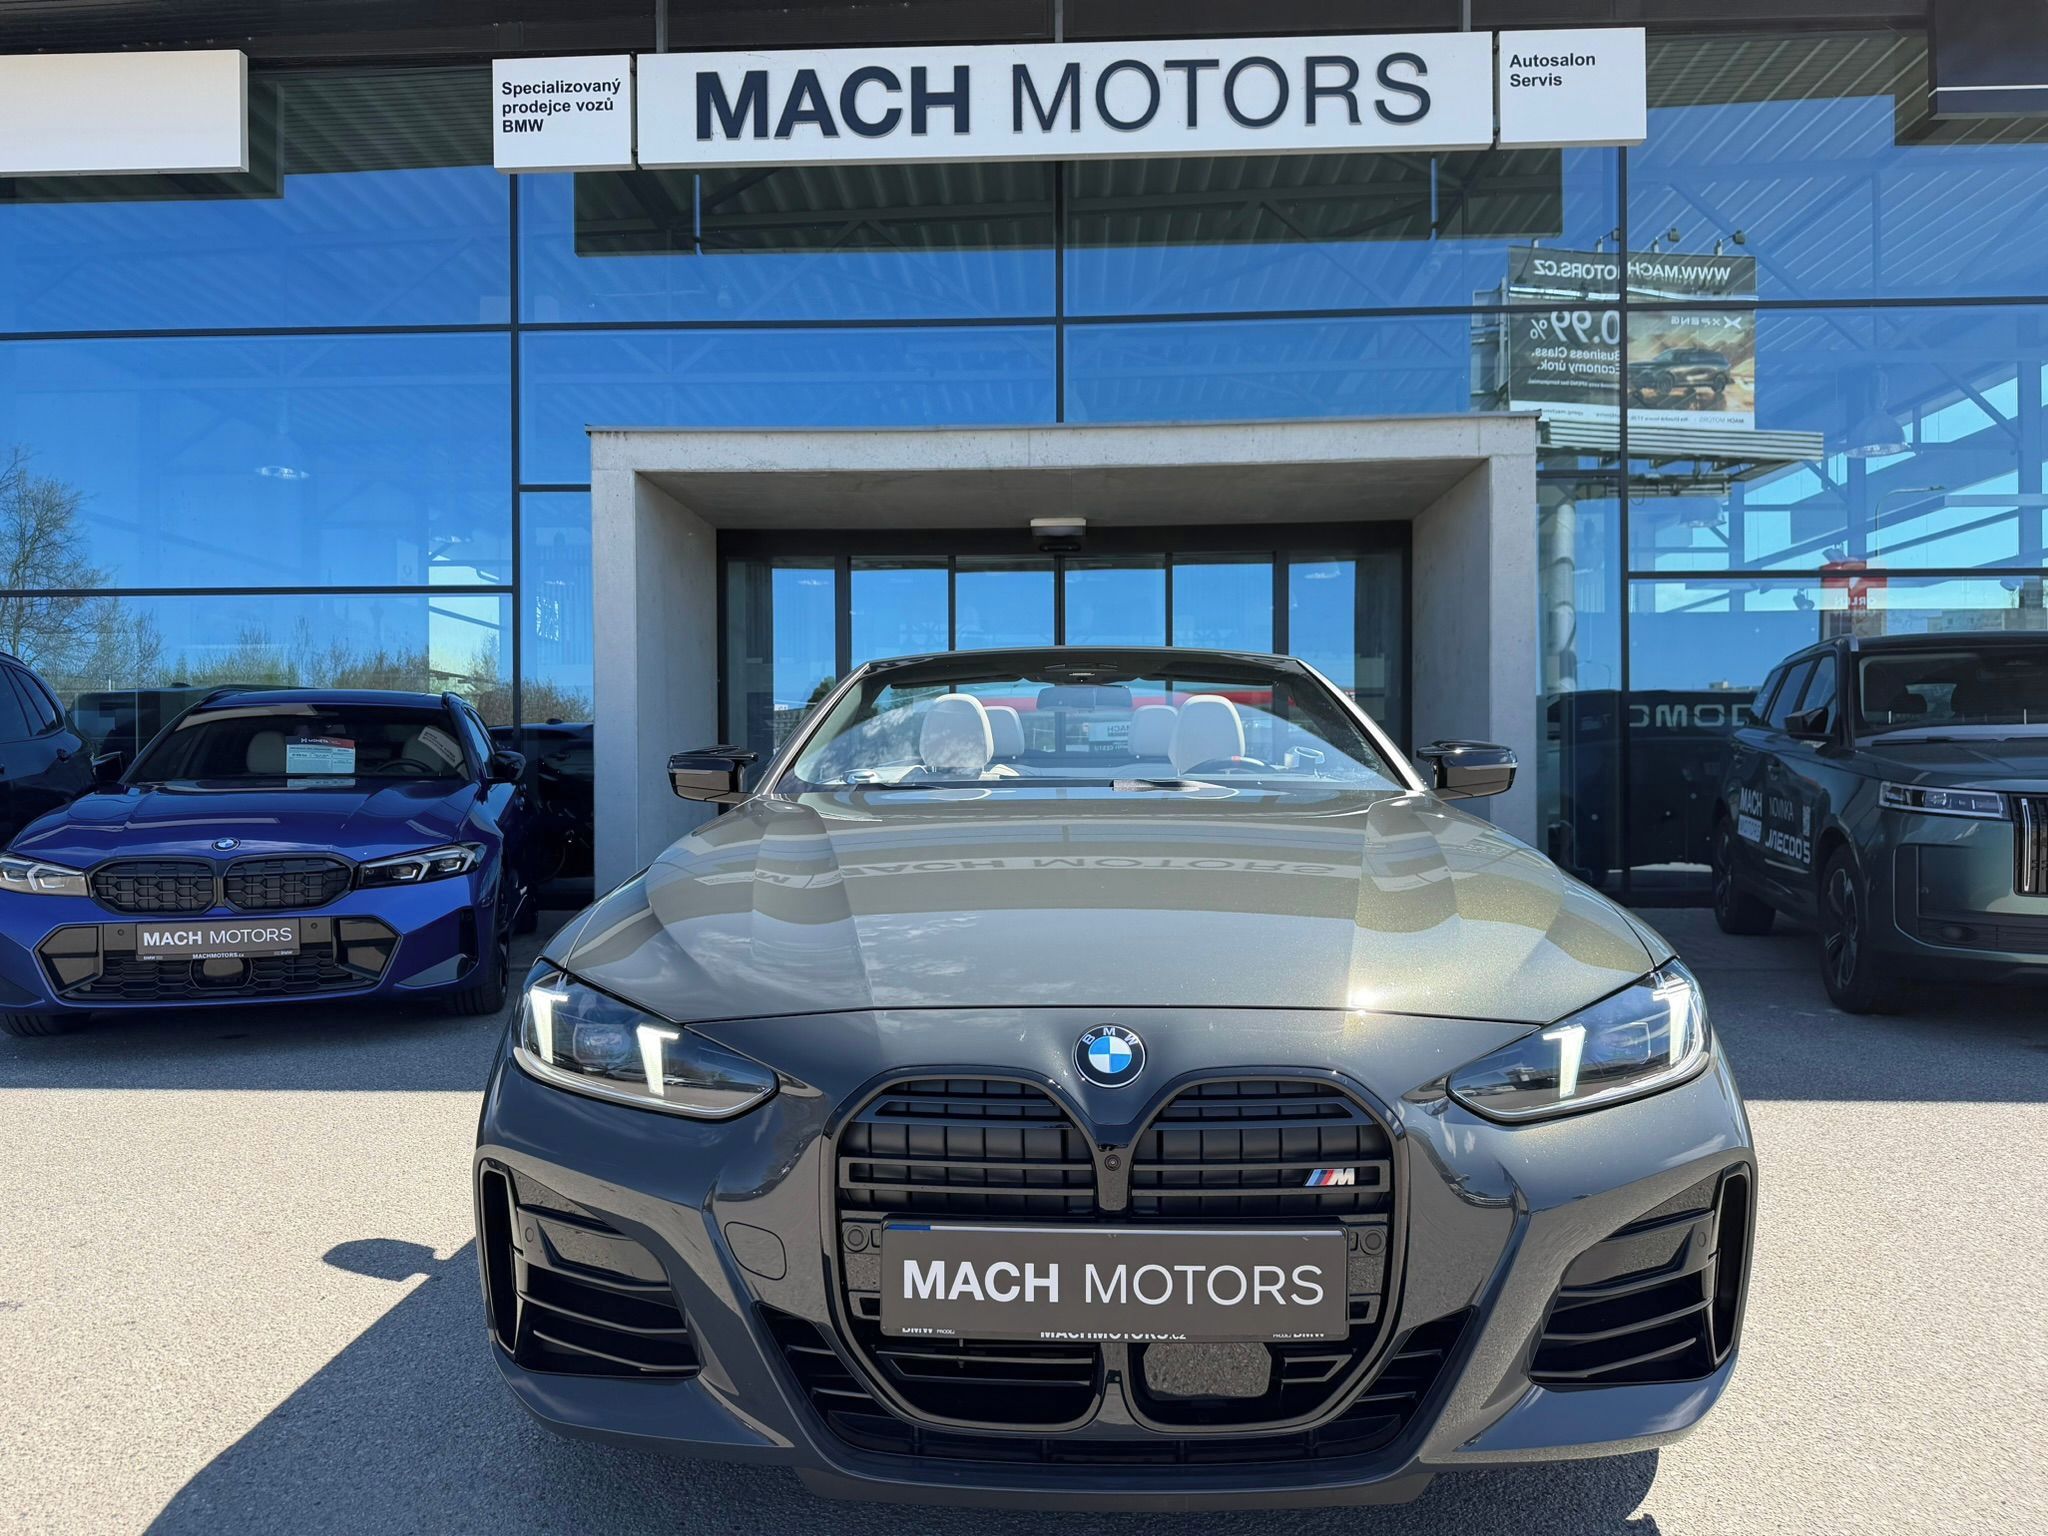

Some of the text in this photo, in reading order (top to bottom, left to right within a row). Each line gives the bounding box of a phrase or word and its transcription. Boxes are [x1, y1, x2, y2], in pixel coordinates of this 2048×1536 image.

[1509, 53, 1596, 68] Autosalon
[501, 78, 621, 98] Specializovaný
[1510, 73, 1563, 87] Servis
[696, 51, 1431, 141] MACH MOTORS
[502, 97, 614, 117] prodejce vozů
[502, 119, 544, 133] BMW
[1740, 787, 1763, 817] MACH
[143, 927, 293, 946] MACH MOTORS
[1082, 1027, 1139, 1046] BMW
[903, 1259, 1325, 1306] MACH MOTORS
